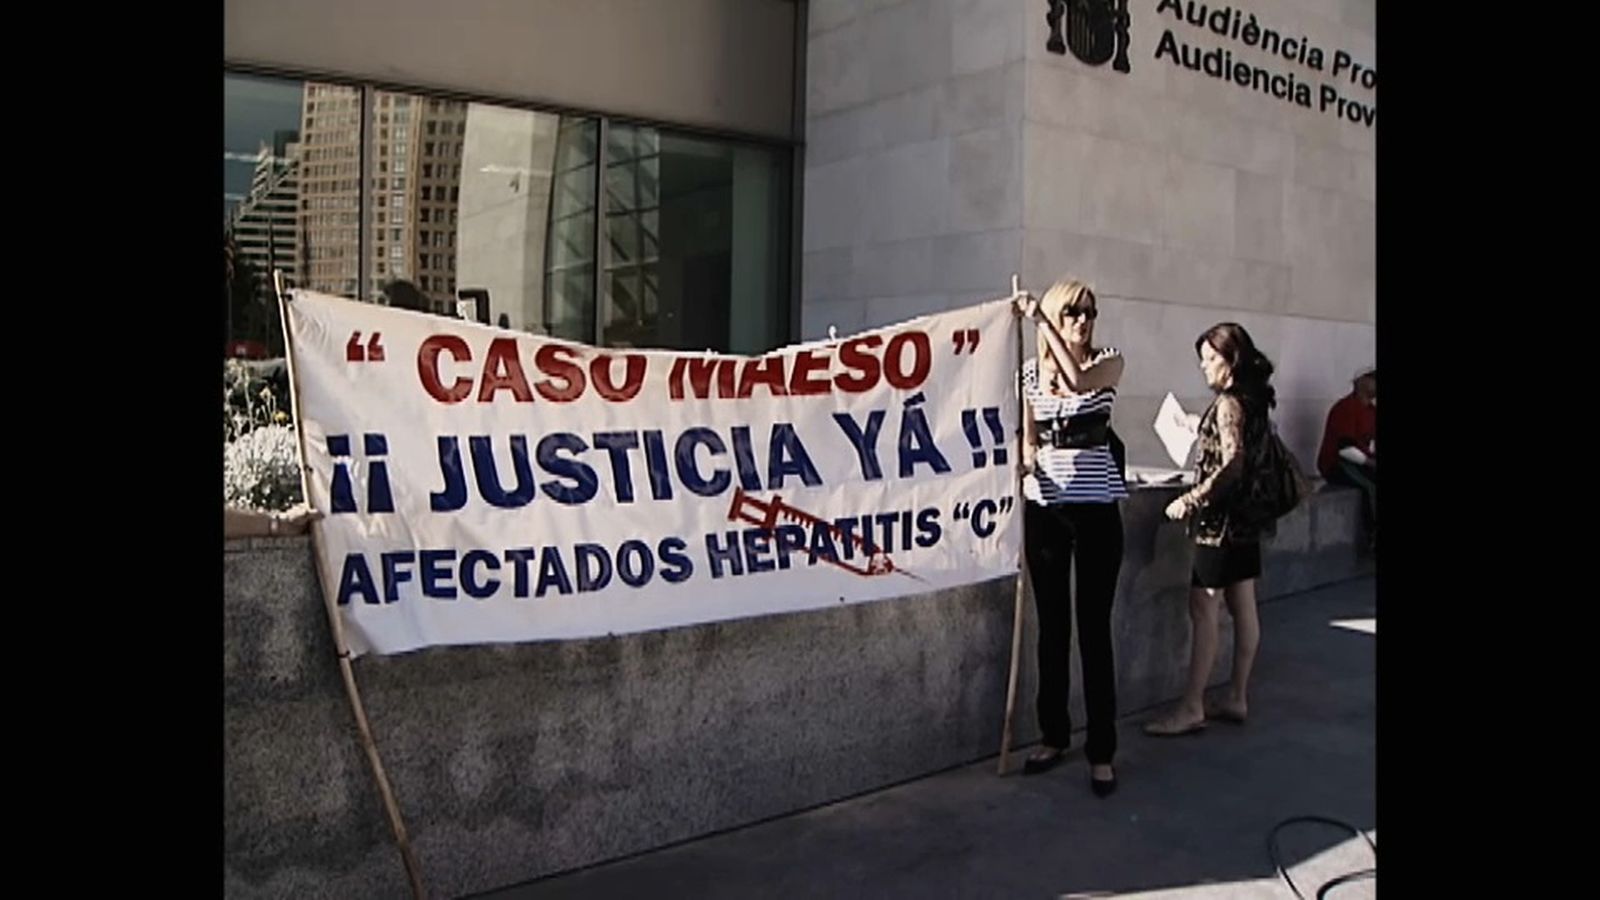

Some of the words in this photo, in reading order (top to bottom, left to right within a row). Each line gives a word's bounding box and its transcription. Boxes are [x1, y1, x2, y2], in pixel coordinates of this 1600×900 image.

[1155, 30, 1311, 108] Audiencia
[1320, 84, 1376, 127] Prov
[417, 334, 648, 405] CASO
[668, 331, 932, 401] MAESO
[429, 422, 823, 513] JUSTICIA
[832, 391, 952, 481] YÁ
[337, 537, 694, 606] AFECTADOS
[705, 508, 942, 579] HEPATITIS
